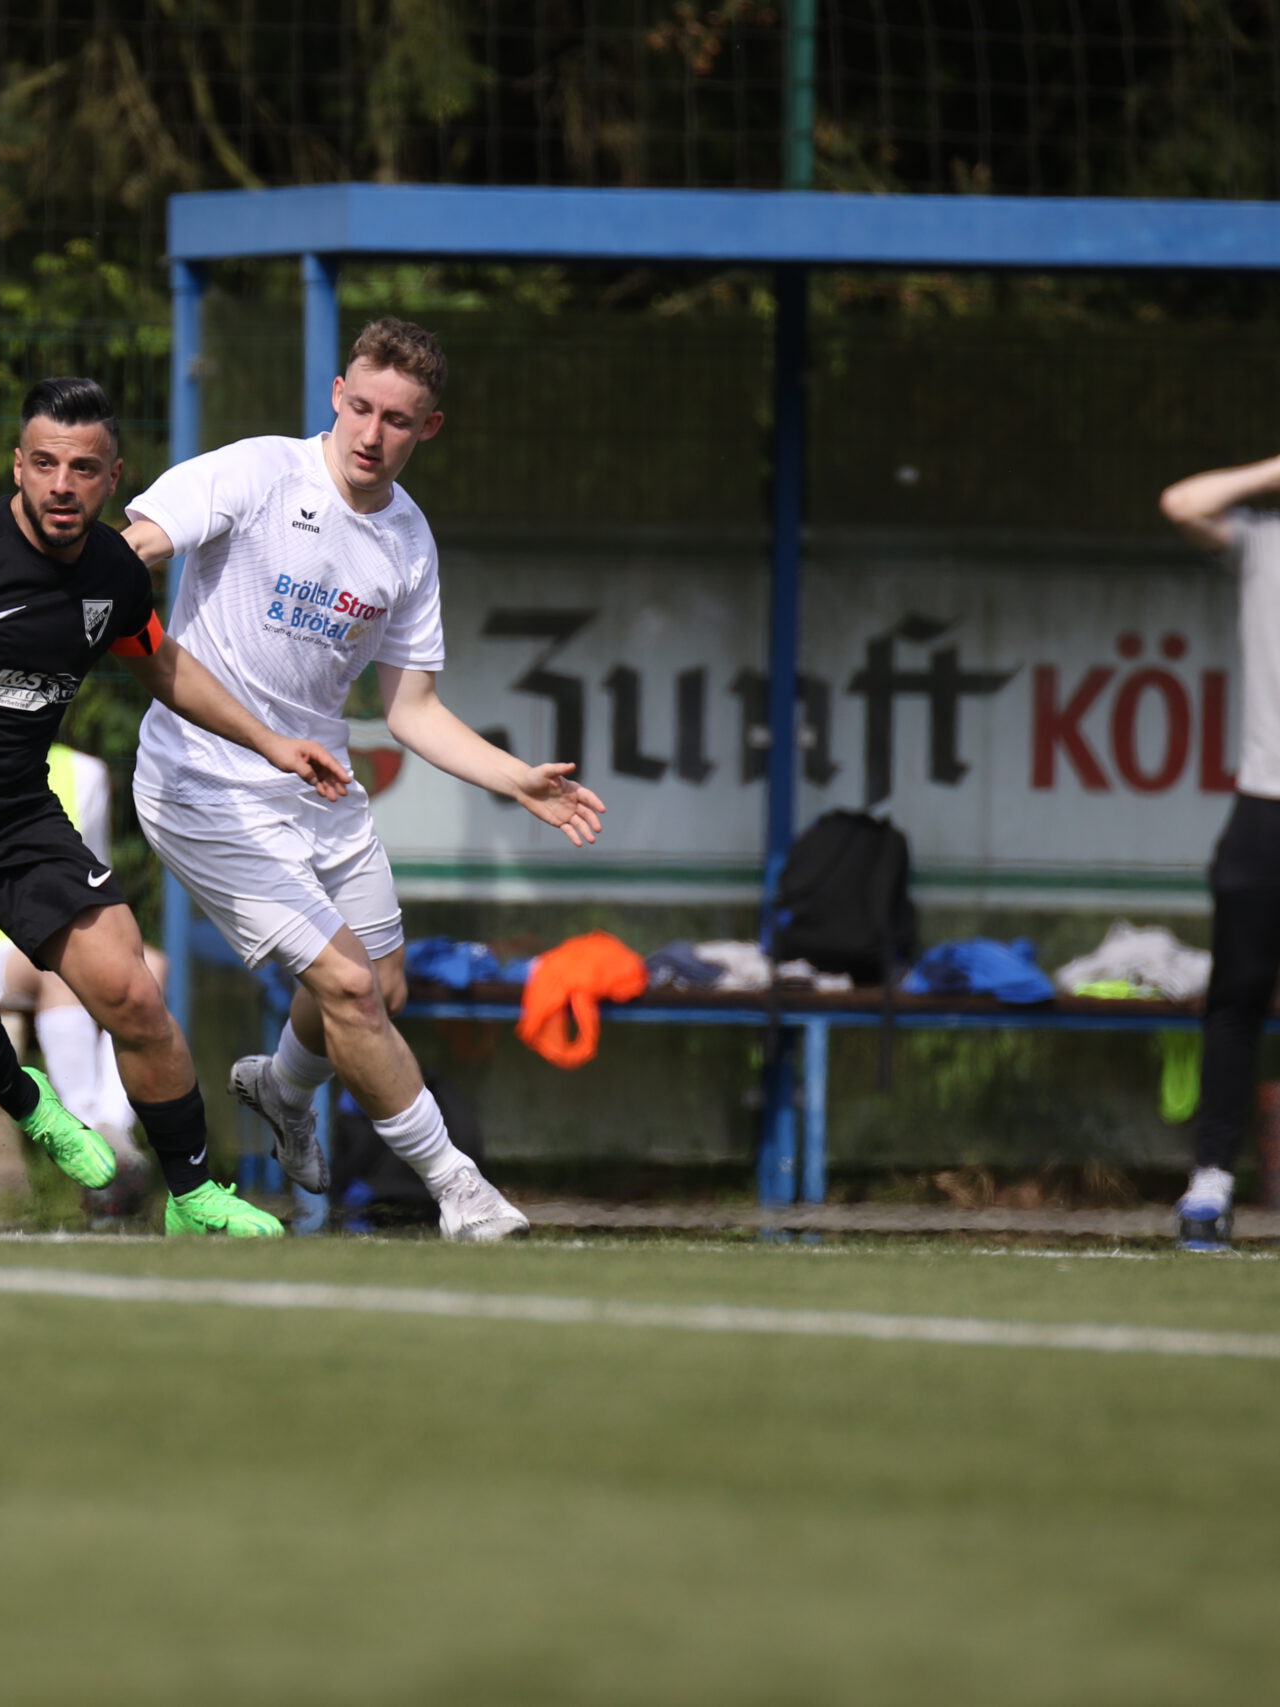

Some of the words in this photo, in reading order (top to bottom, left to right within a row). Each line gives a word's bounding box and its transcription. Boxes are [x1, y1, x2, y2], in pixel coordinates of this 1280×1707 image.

[292, 520, 320, 534] erima
[267, 601, 284, 621] &
[476, 607, 1023, 806] Zunft
